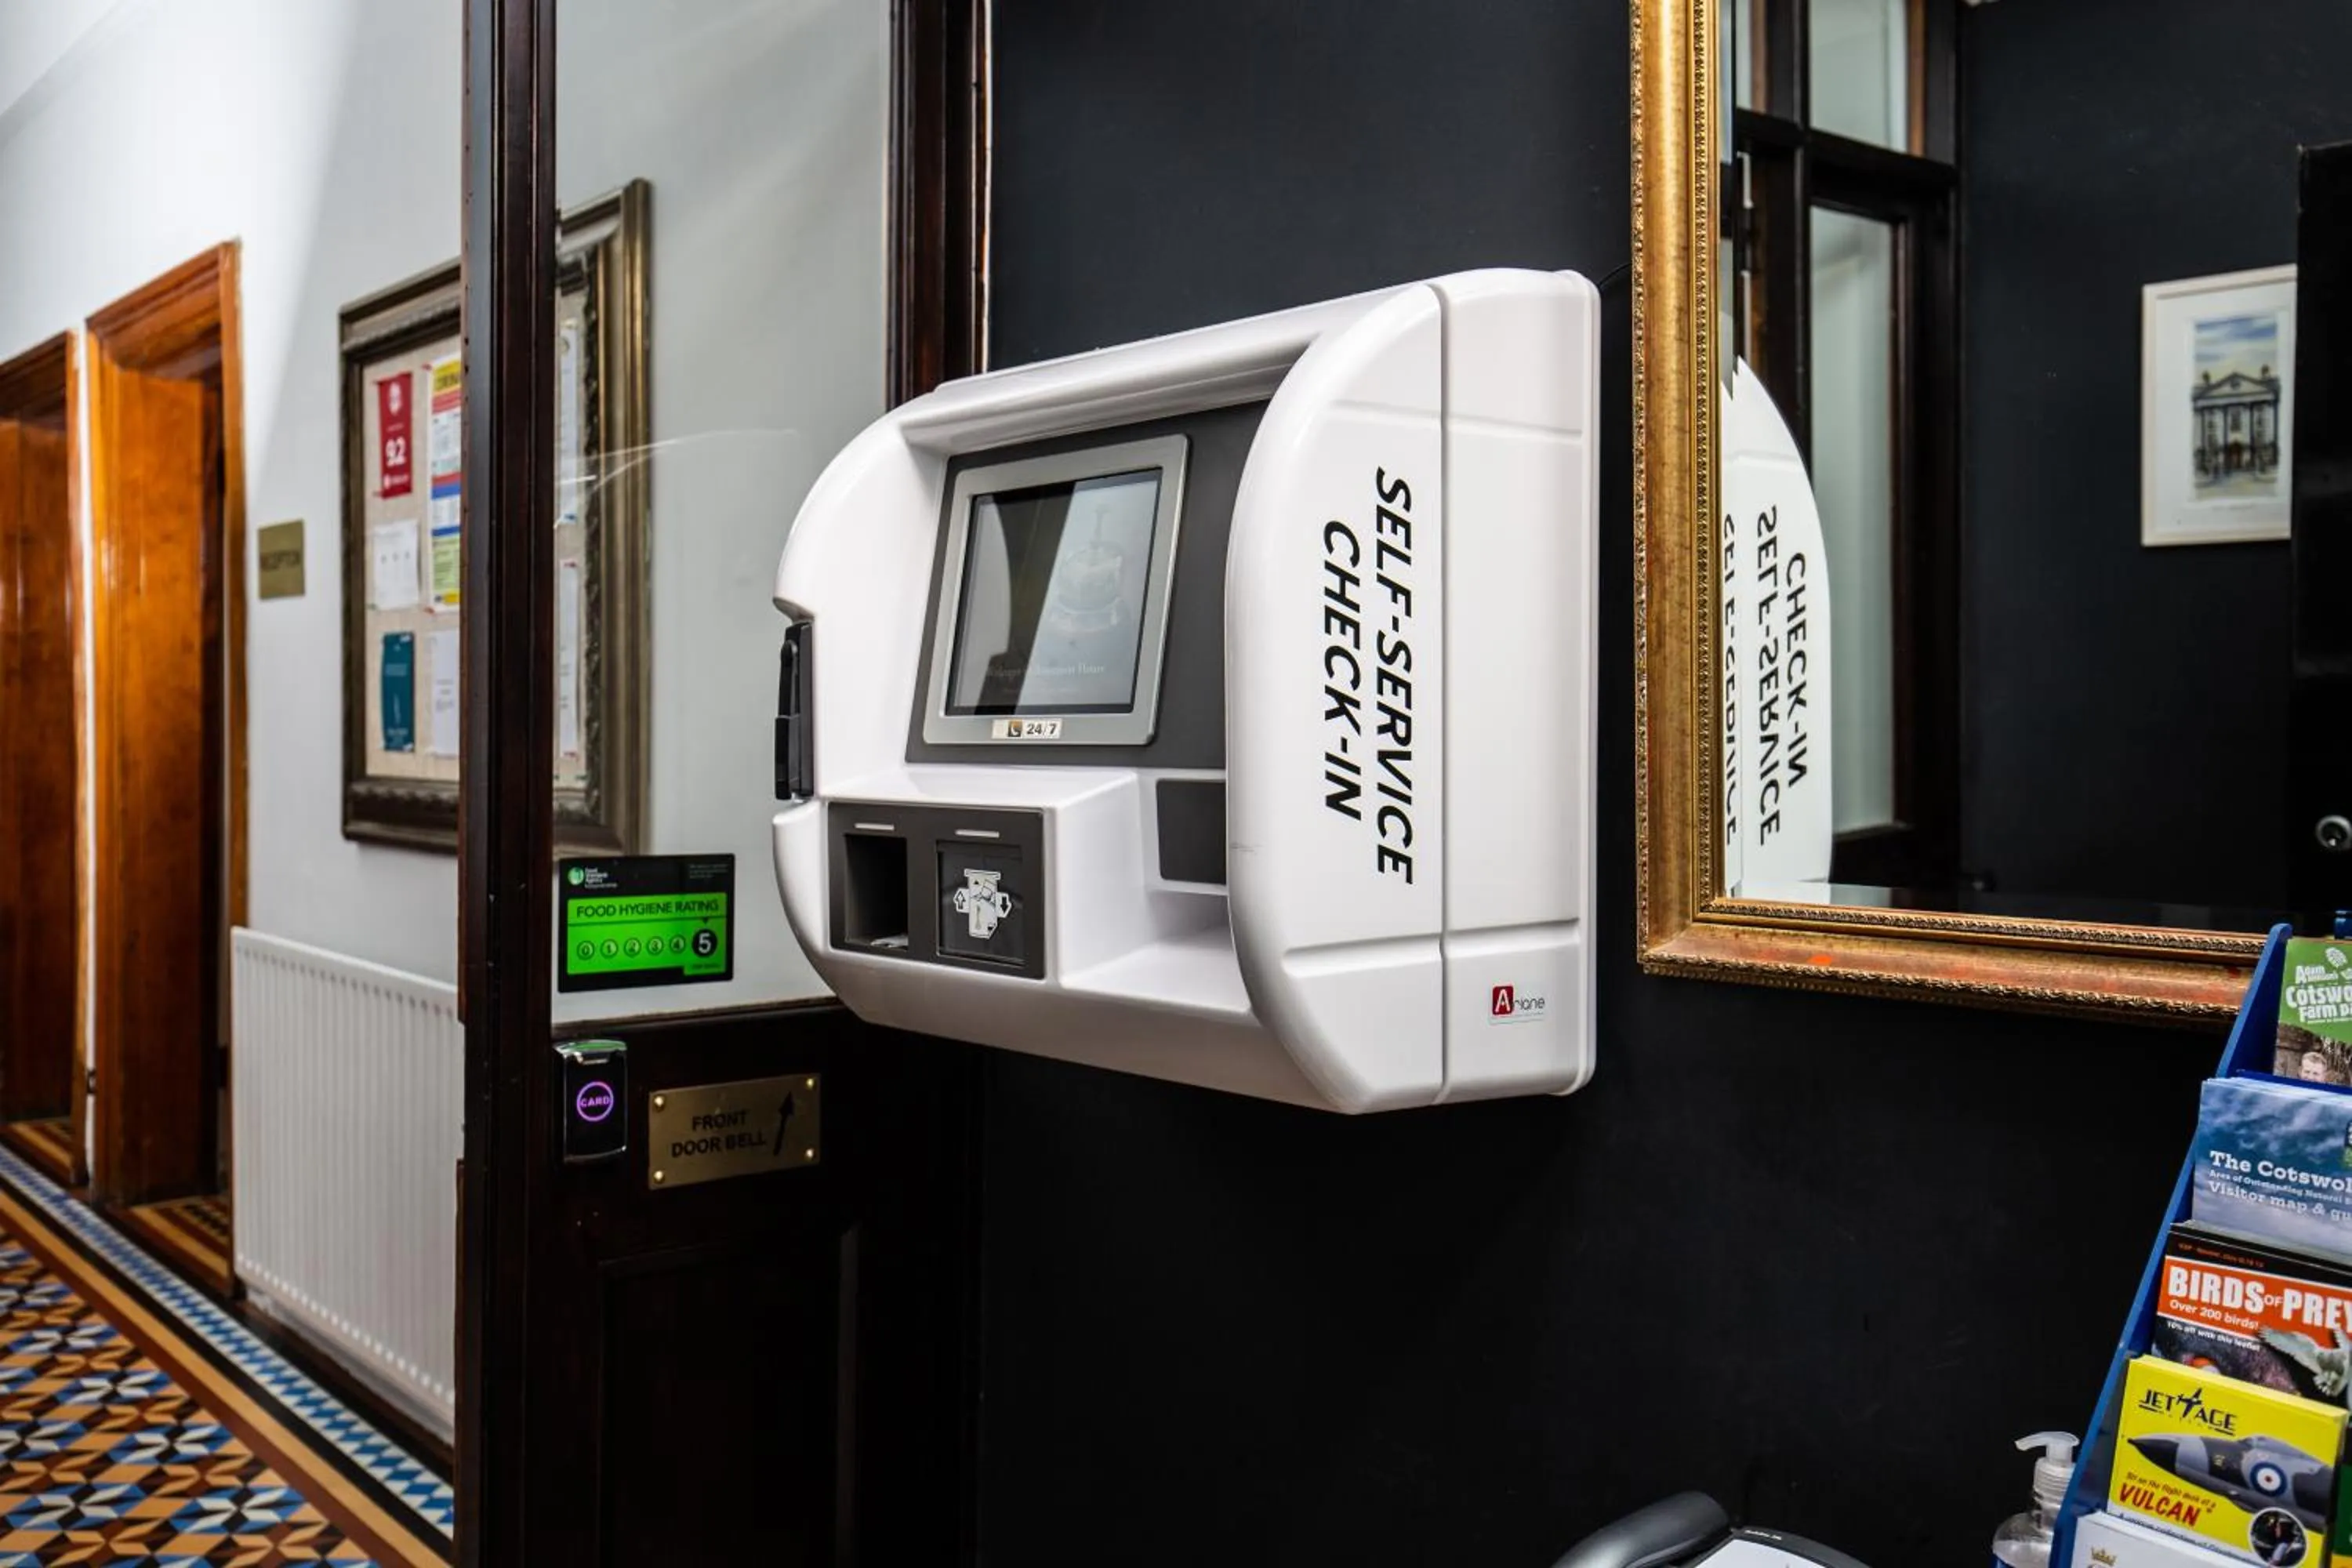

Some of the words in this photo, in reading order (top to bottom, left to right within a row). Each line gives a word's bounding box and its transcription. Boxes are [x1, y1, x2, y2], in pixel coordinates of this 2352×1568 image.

[1323, 520, 1361, 822] CHECK-IN
[1376, 466, 1413, 884] SELF-SERVICE
[1026, 723, 1058, 735] 24/7
[576, 904, 616, 918] FOOD
[619, 902, 673, 916] HYGIENE
[675, 899, 719, 913] RATING
[698, 932, 712, 954] 5
[2298, 1004, 2338, 1023] Farm
[2339, 1003, 2352, 1017] P
[580, 1096, 609, 1107] CARD
[692, 1109, 750, 1131] FRONT
[672, 1137, 721, 1158] DOOR
[725, 1131, 767, 1150] BELL
[2209, 1150, 2252, 1172] The
[2232, 1175, 2242, 1184] of
[2208, 1180, 2267, 1203] Visitor
[2270, 1196, 2307, 1214] map
[2312, 1202, 2326, 1215] &
[2168, 1265, 2265, 1314] BIRDS
[2263, 1294, 2283, 1308] OF
[2169, 1299, 2198, 1313] Over
[2199, 1307, 2223, 1321] 200
[2223, 1312, 2259, 1330] birds!
[2198, 1330, 2216, 1340] with
[2217, 1334, 2234, 1344] this
[2139, 1389, 2176, 1412] JET
[2194, 1406, 2237, 1431] AGE
[2119, 1482, 2201, 1527] VULCAN
